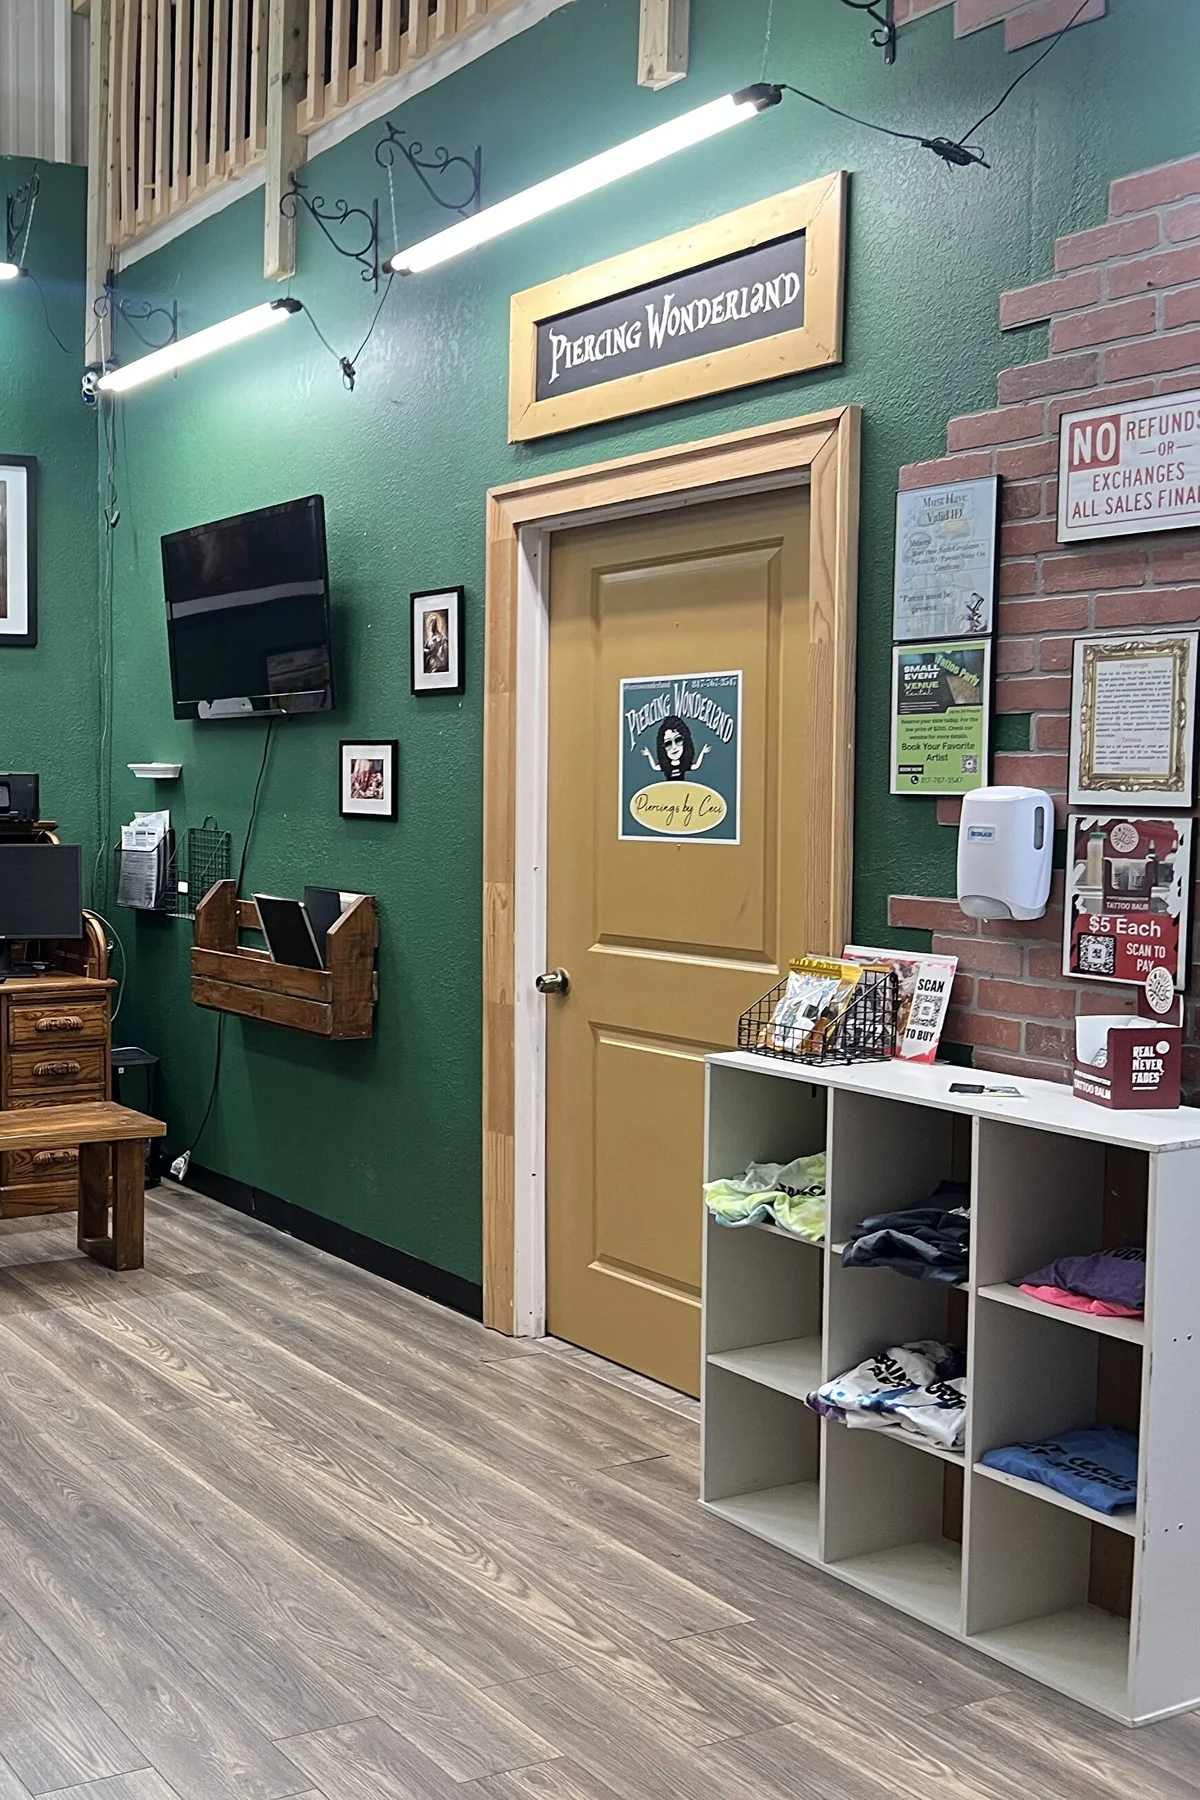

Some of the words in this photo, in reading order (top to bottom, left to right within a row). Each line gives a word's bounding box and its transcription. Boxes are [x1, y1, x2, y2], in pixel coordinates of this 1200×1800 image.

[548, 320, 642, 385] PIERCING
[1073, 422, 1116, 466] NO
[1158, 440, 1174, 457] OR
[1092, 461, 1185, 493] EXCHANGES
[1072, 499, 1099, 520] ALL
[1105, 491, 1153, 515] SALES
[927, 510, 949, 523] Valid
[903, 664, 941, 673] SMALL
[904, 672, 939, 681] EVENT
[903, 681, 939, 690] VENUE
[901, 742, 921, 751] Book
[922, 742, 941, 750] Your
[942, 741, 975, 751] Favorite
[926, 753, 949, 762] Artist
[635, 793, 680, 826] Piercings
[682, 793, 694, 826] by
[698, 794, 723, 817] Ceci
[1106, 901, 1131, 910] TATTOO
[1088, 916, 1111, 933] $5
[1116, 918, 1161, 938] Each
[1126, 942, 1152, 958] SCAN
[1153, 945, 1166, 958] TO
[1136, 958, 1154, 973] PAY
[917, 977, 946, 994] SCAN
[906, 1027, 917, 1040] TO
[917, 1028, 935, 1042] BUY
[1132, 1045, 1156, 1060] REAL
[1132, 1058, 1165, 1074] NEVER
[1131, 1071, 1160, 1084] FADES
